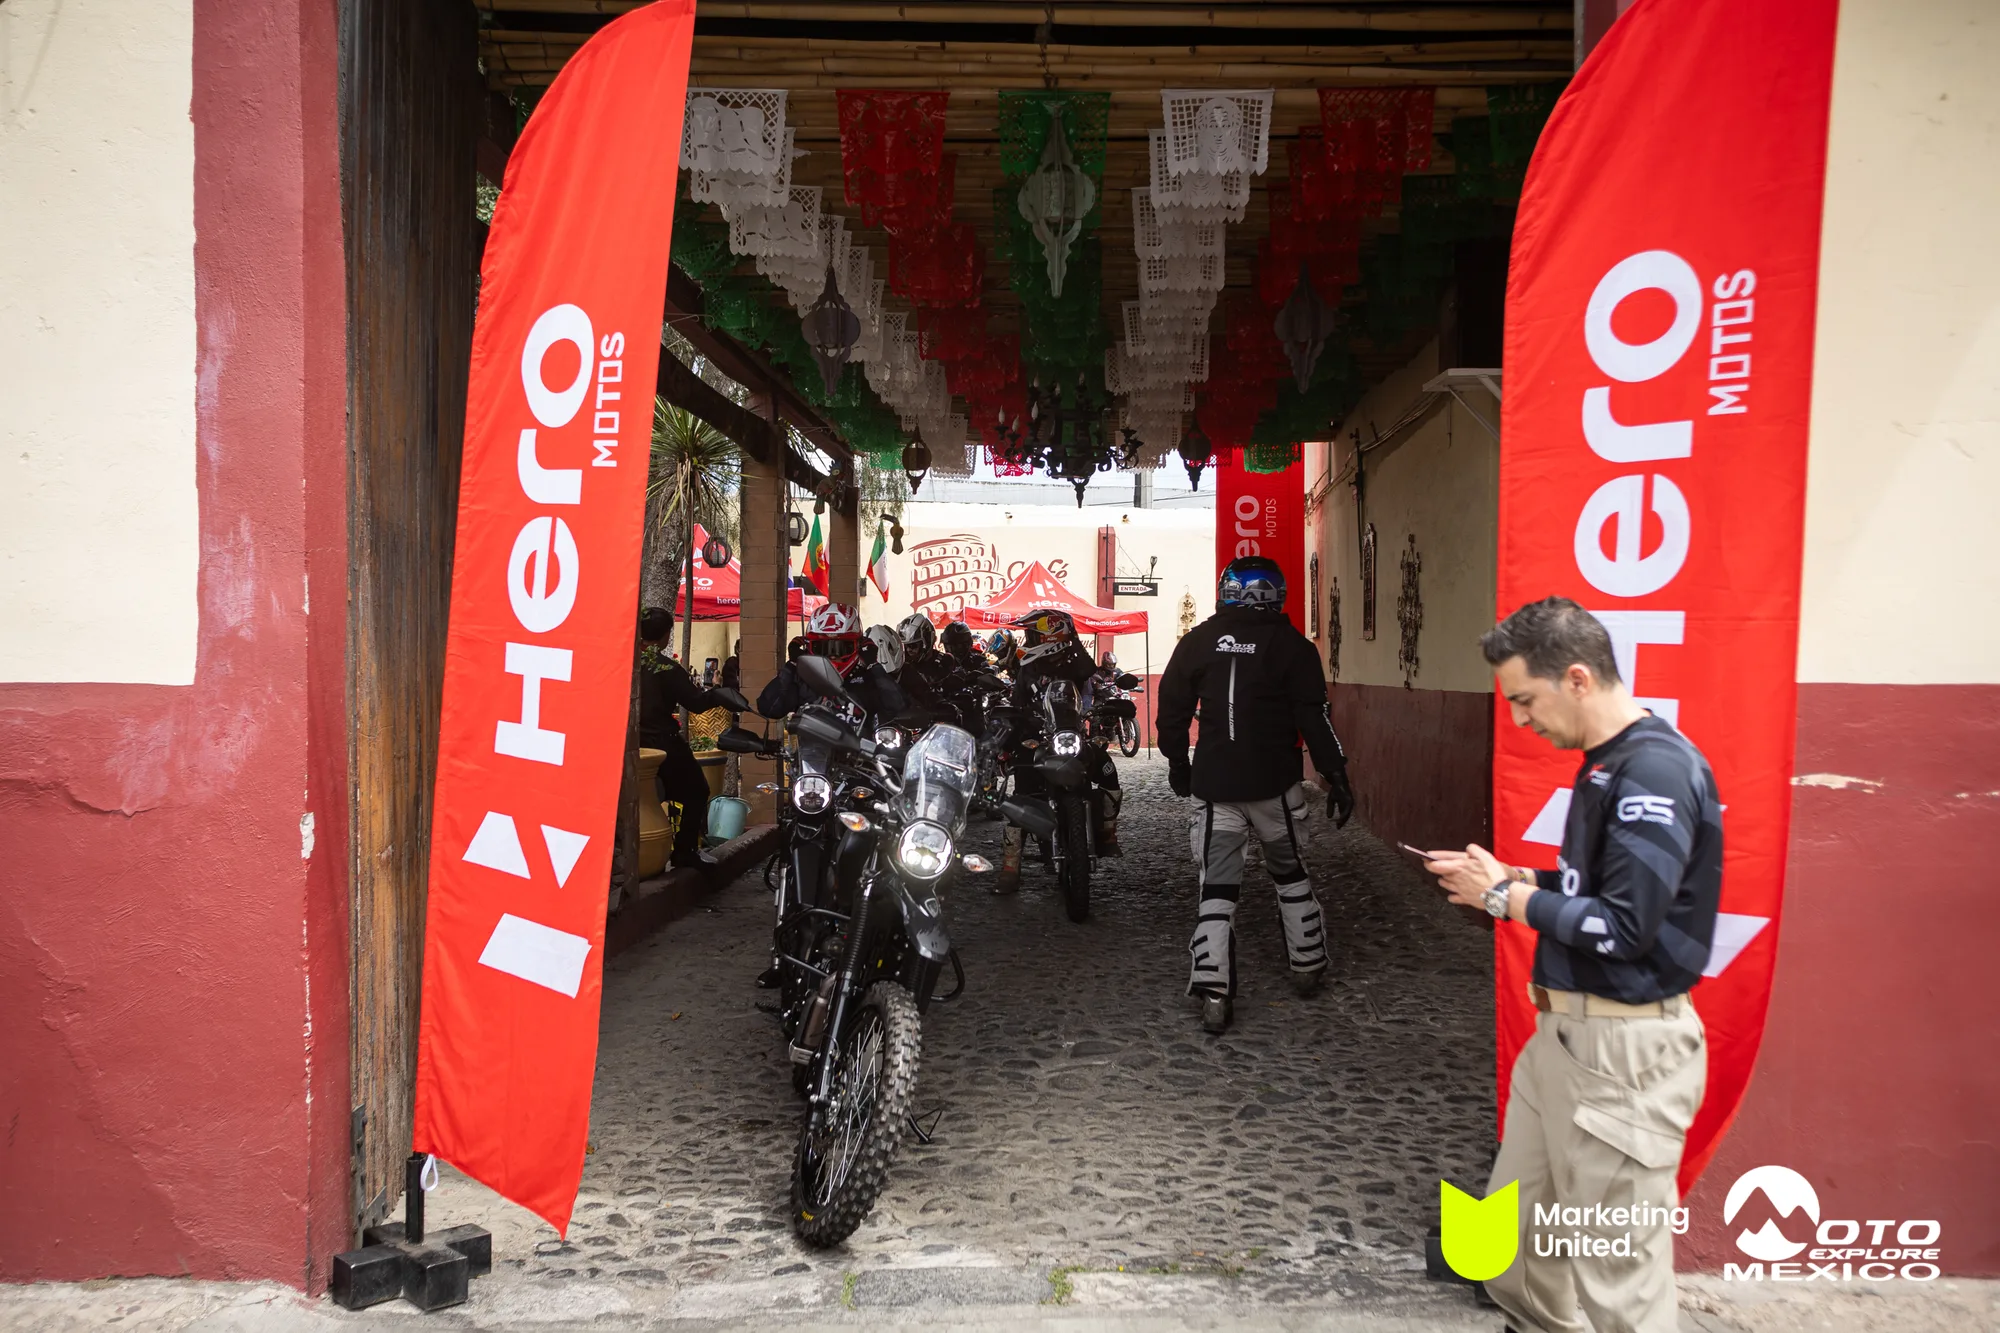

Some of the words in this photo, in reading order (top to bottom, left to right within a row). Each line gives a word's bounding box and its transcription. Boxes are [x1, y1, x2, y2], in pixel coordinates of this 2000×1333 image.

[1707, 269, 1757, 416] MOTOS
[592, 331, 625, 468] MOTOS
[1574, 249, 1703, 731] Hero
[494, 303, 595, 766] Hero
[1234, 495, 1260, 558] ero
[1266, 498, 1277, 538] MOTOS
[1007, 559, 1069, 585] Cfé
[1027, 600, 1072, 609] Hero
[1085, 618, 1130, 627] heromotos.mx
[1617, 795, 1675, 822] GS
